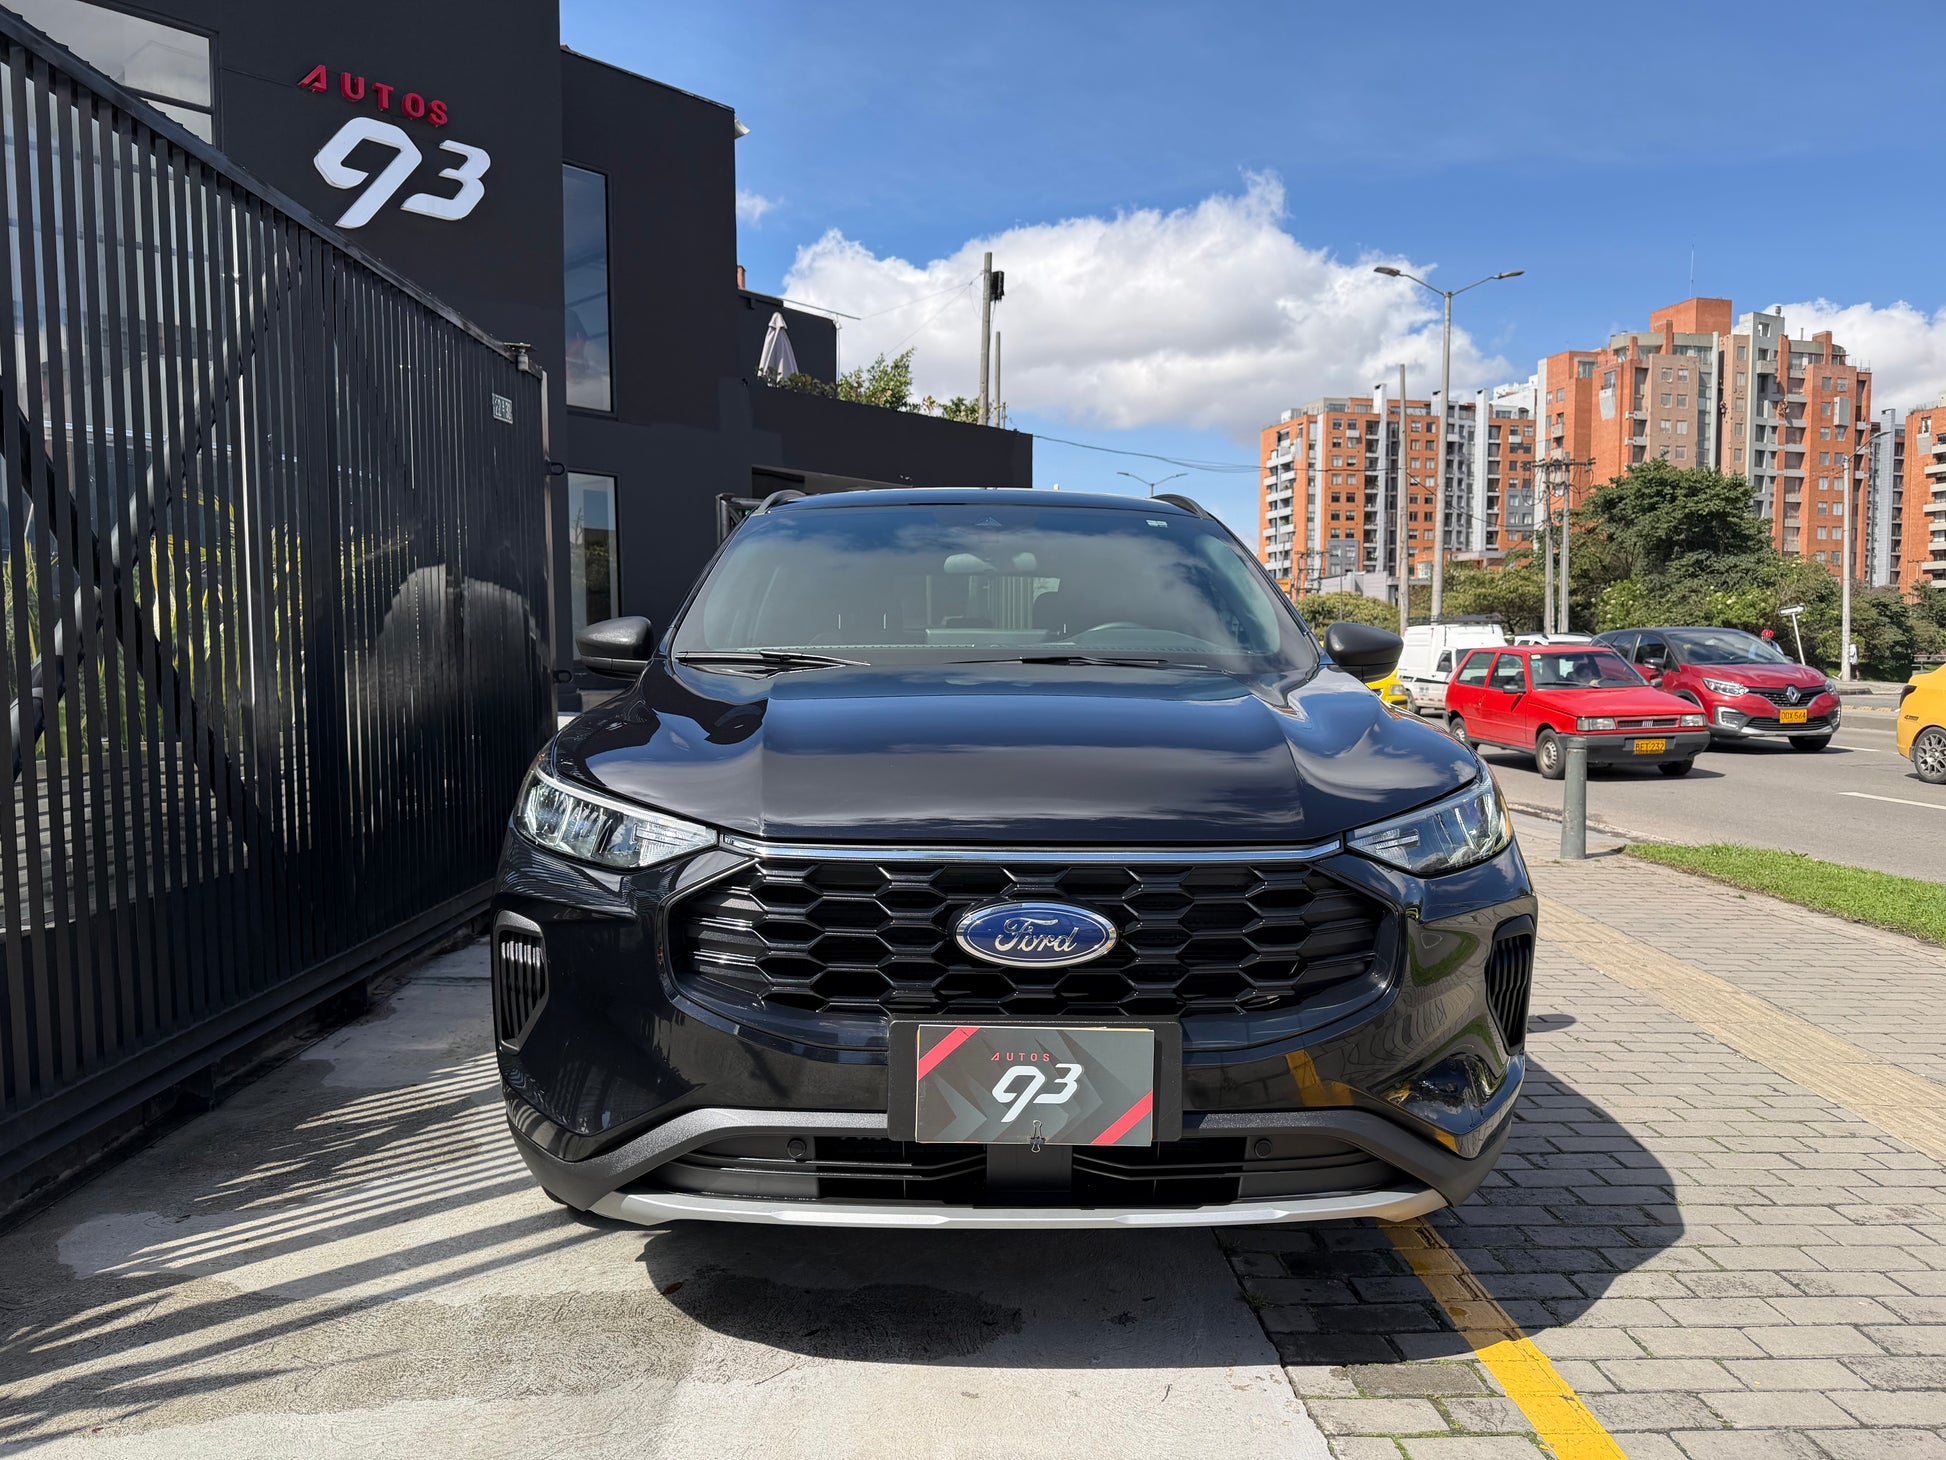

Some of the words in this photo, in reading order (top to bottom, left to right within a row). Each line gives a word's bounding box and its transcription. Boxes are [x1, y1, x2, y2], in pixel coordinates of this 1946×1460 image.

[297, 64, 448, 127] AUTOS
[313, 116, 491, 229] 93
[994, 917, 1080, 952] Ford
[990, 1052, 1050, 1062] AUTOS
[991, 1063, 1083, 1123] 93
